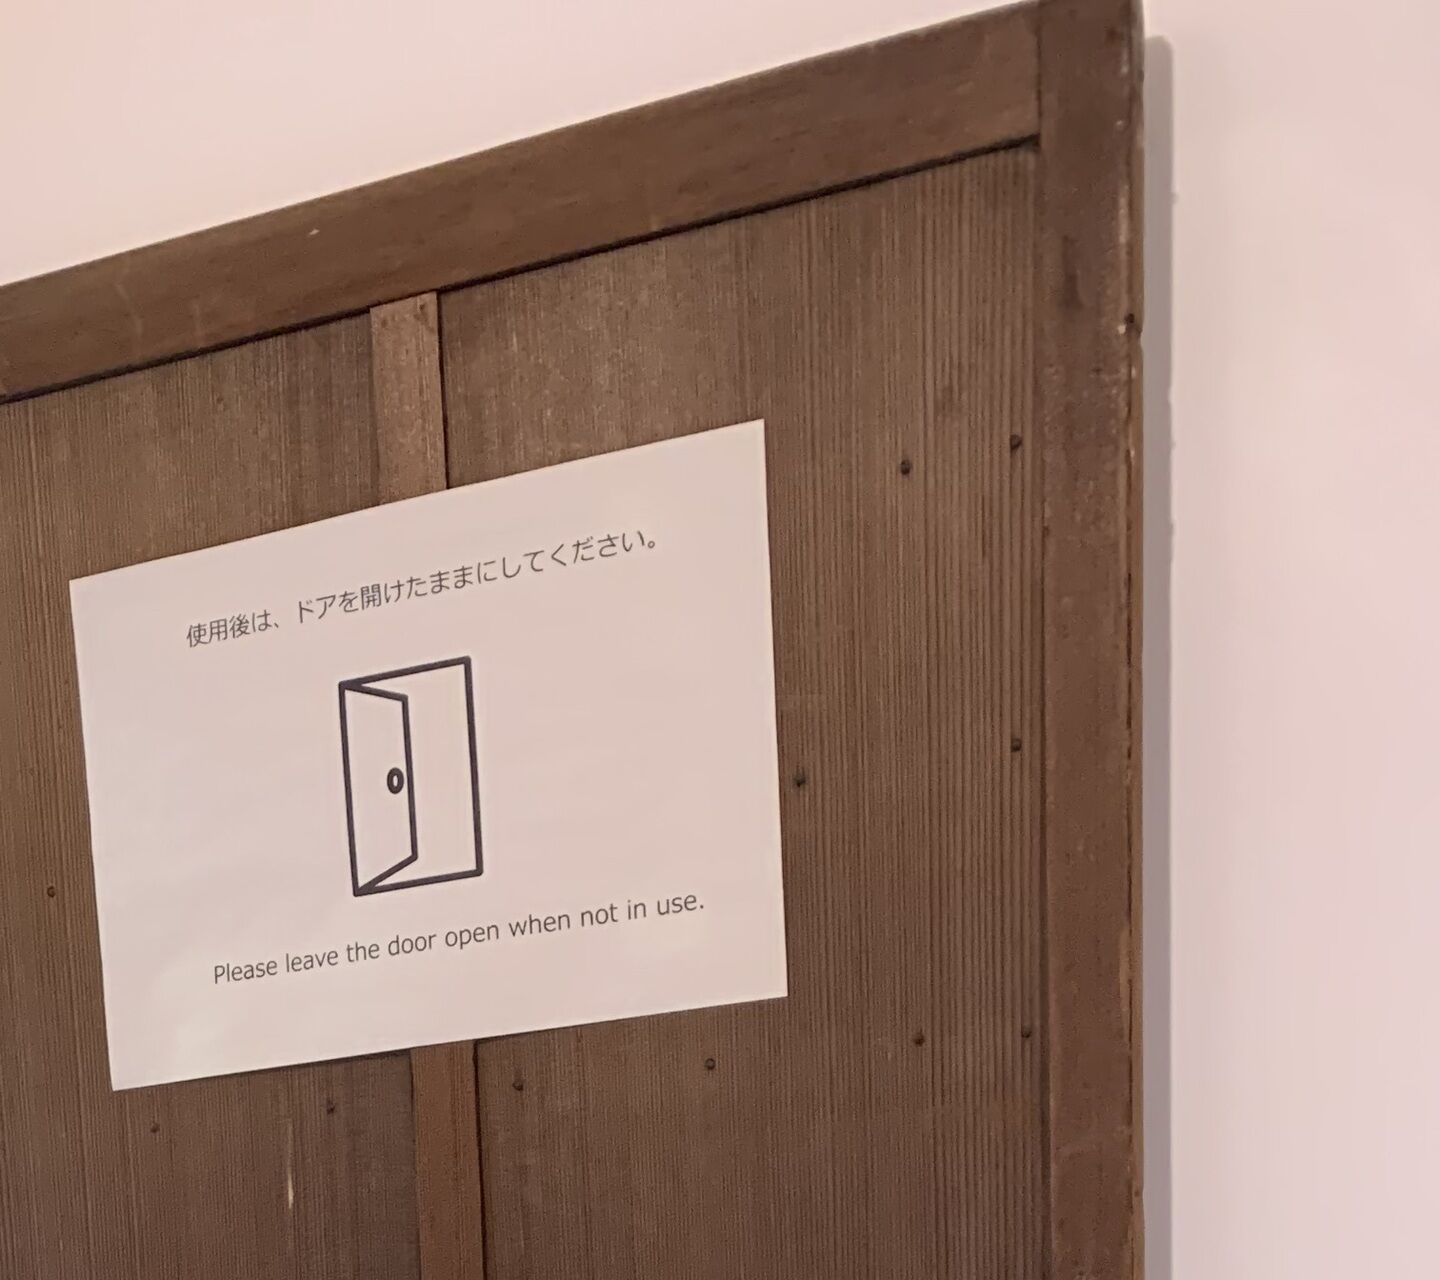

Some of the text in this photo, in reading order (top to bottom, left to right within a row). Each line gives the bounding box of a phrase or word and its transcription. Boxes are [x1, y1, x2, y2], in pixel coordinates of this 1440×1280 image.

[186, 529, 657, 649] 使用後は、ドアを開けたままにしてください。
[213, 894, 705, 985] Please leave the door open when not in use.
